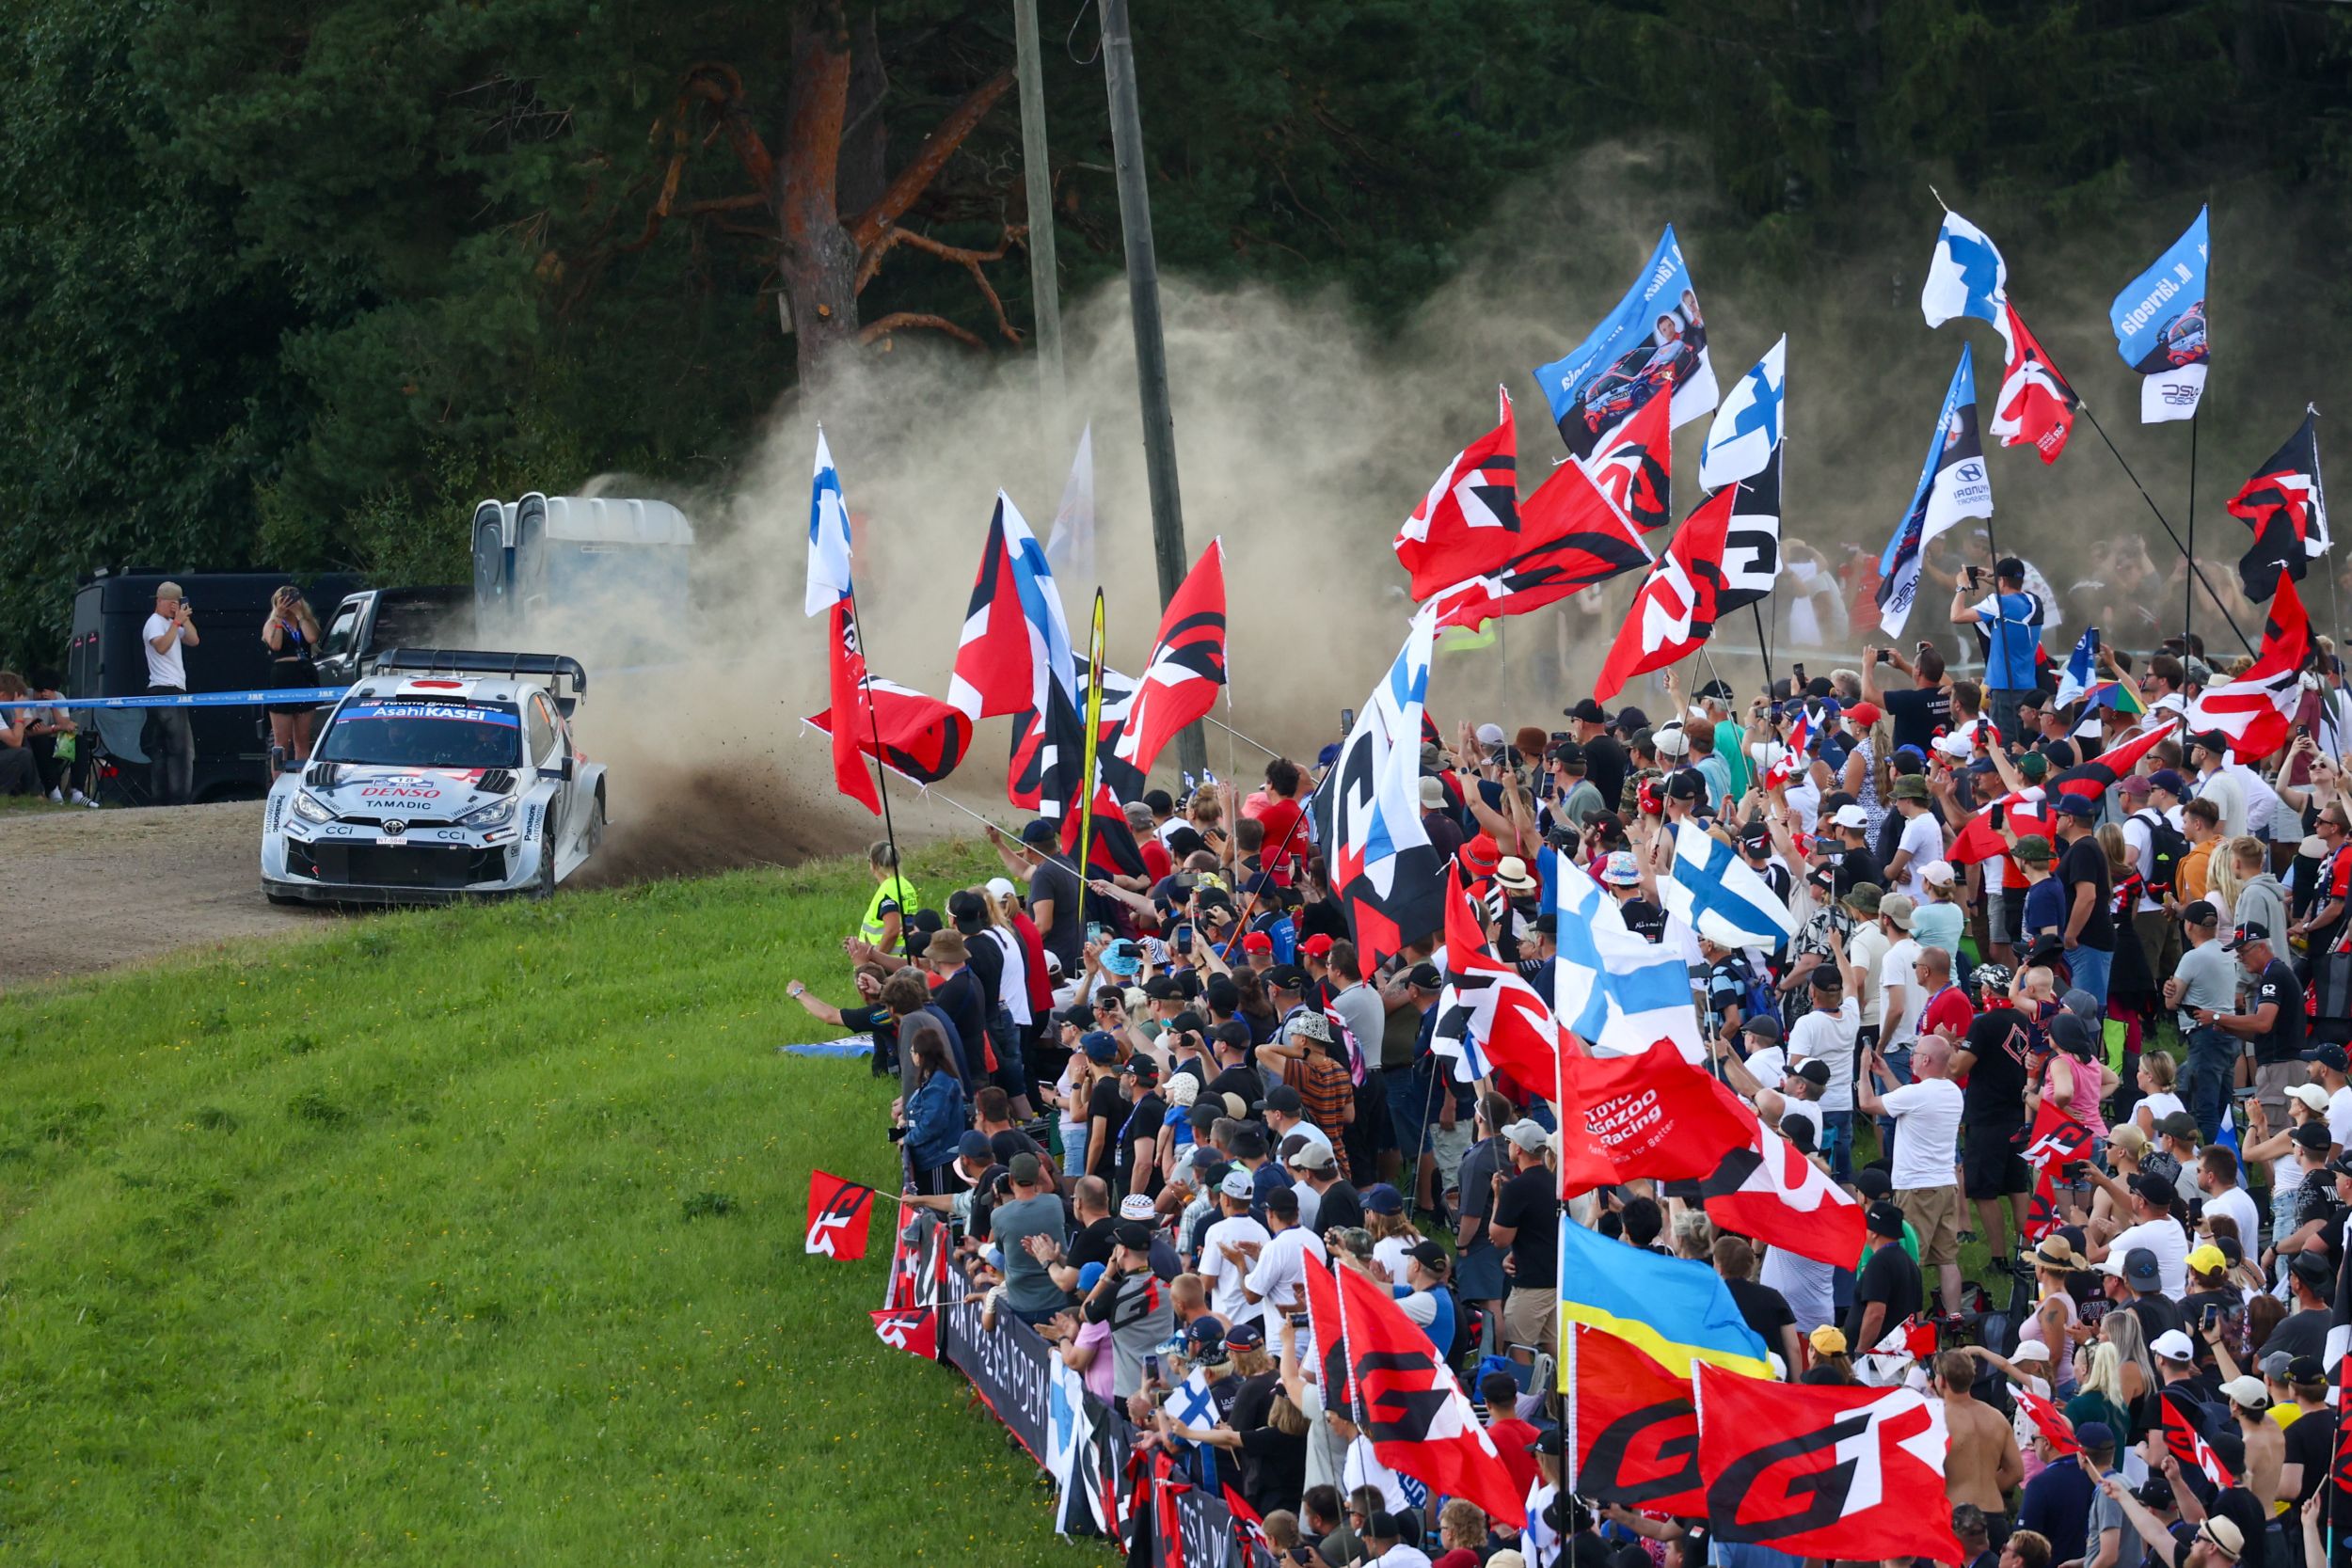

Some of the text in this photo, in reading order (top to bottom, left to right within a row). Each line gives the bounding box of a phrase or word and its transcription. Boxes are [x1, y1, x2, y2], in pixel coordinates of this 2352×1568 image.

[361, 787, 441, 799] DENSO
[366, 800, 432, 810] TAMADIC
[273, 795, 286, 833] Panasonic
[524, 803, 537, 841] Panasonic
[533, 804, 545, 843] AUTOMOTIVE
[2262, 984, 2276, 995] 62
[1594, 1089, 1657, 1135] GAZOO
[1599, 1104, 1662, 1147] Racing
[1647, 1119, 1675, 1148] Better
[1708, 1387, 1950, 1544] GR
